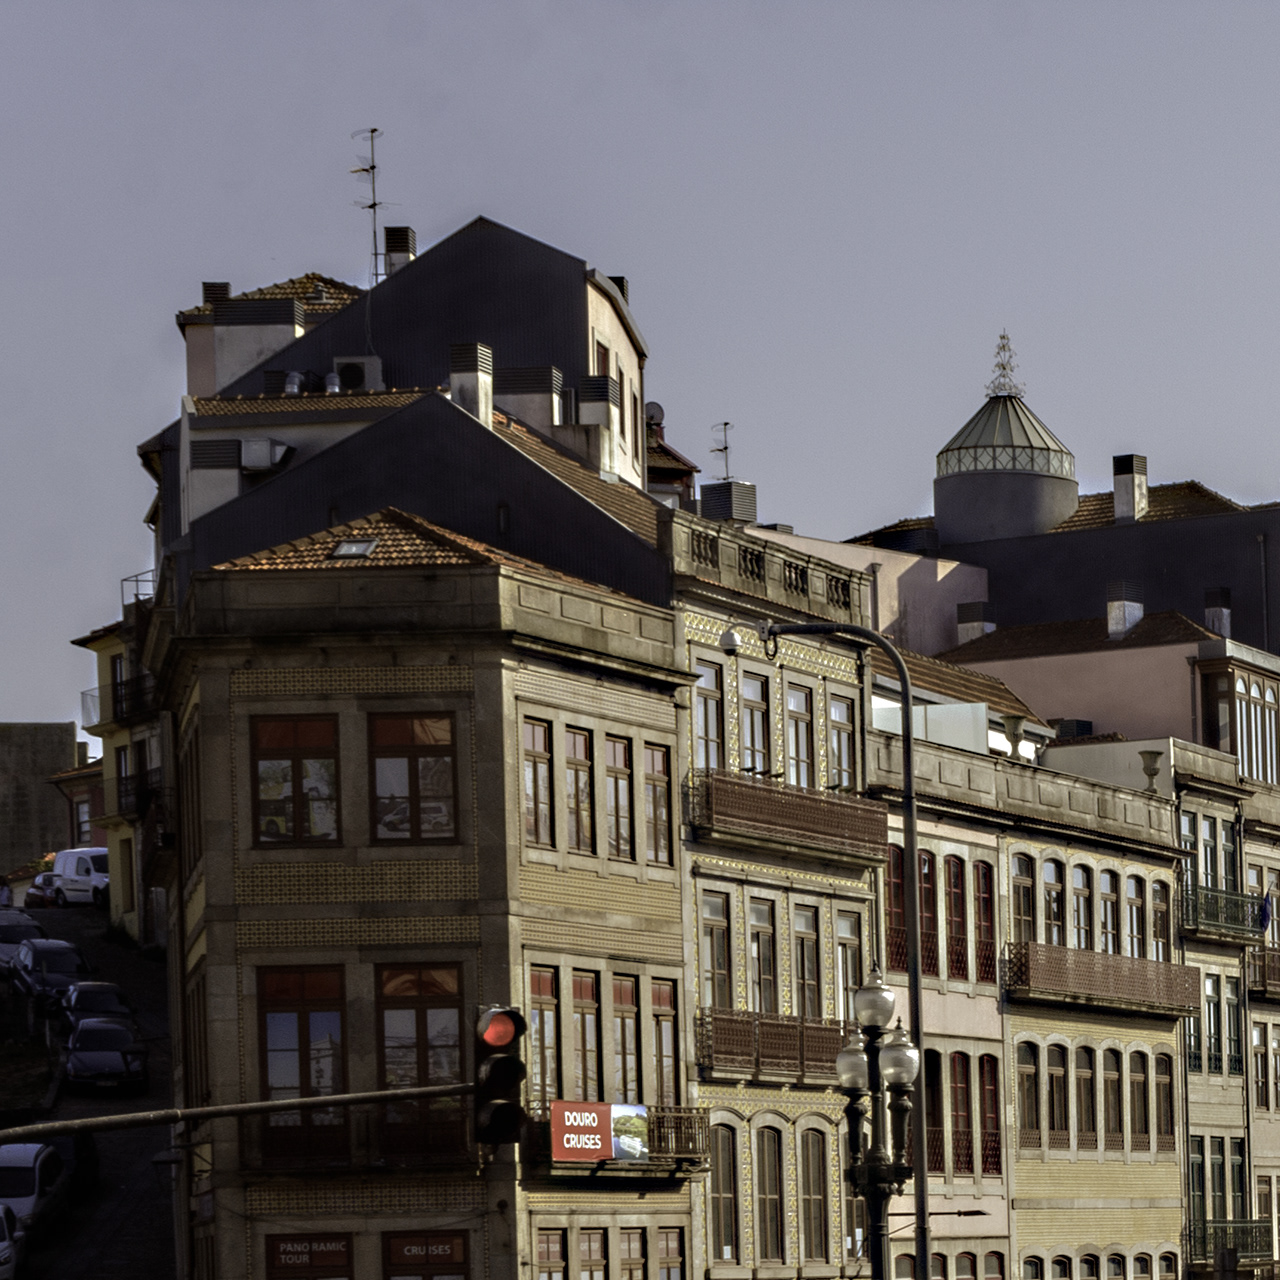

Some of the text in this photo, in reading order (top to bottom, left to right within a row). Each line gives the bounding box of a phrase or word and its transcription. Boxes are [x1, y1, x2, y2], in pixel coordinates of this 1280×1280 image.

[564, 1111, 598, 1127] DOURO
[563, 1133, 602, 1149] CRUISES
[403, 1245, 451, 1256] CRUISES
[280, 1254, 310, 1264] TOUR
